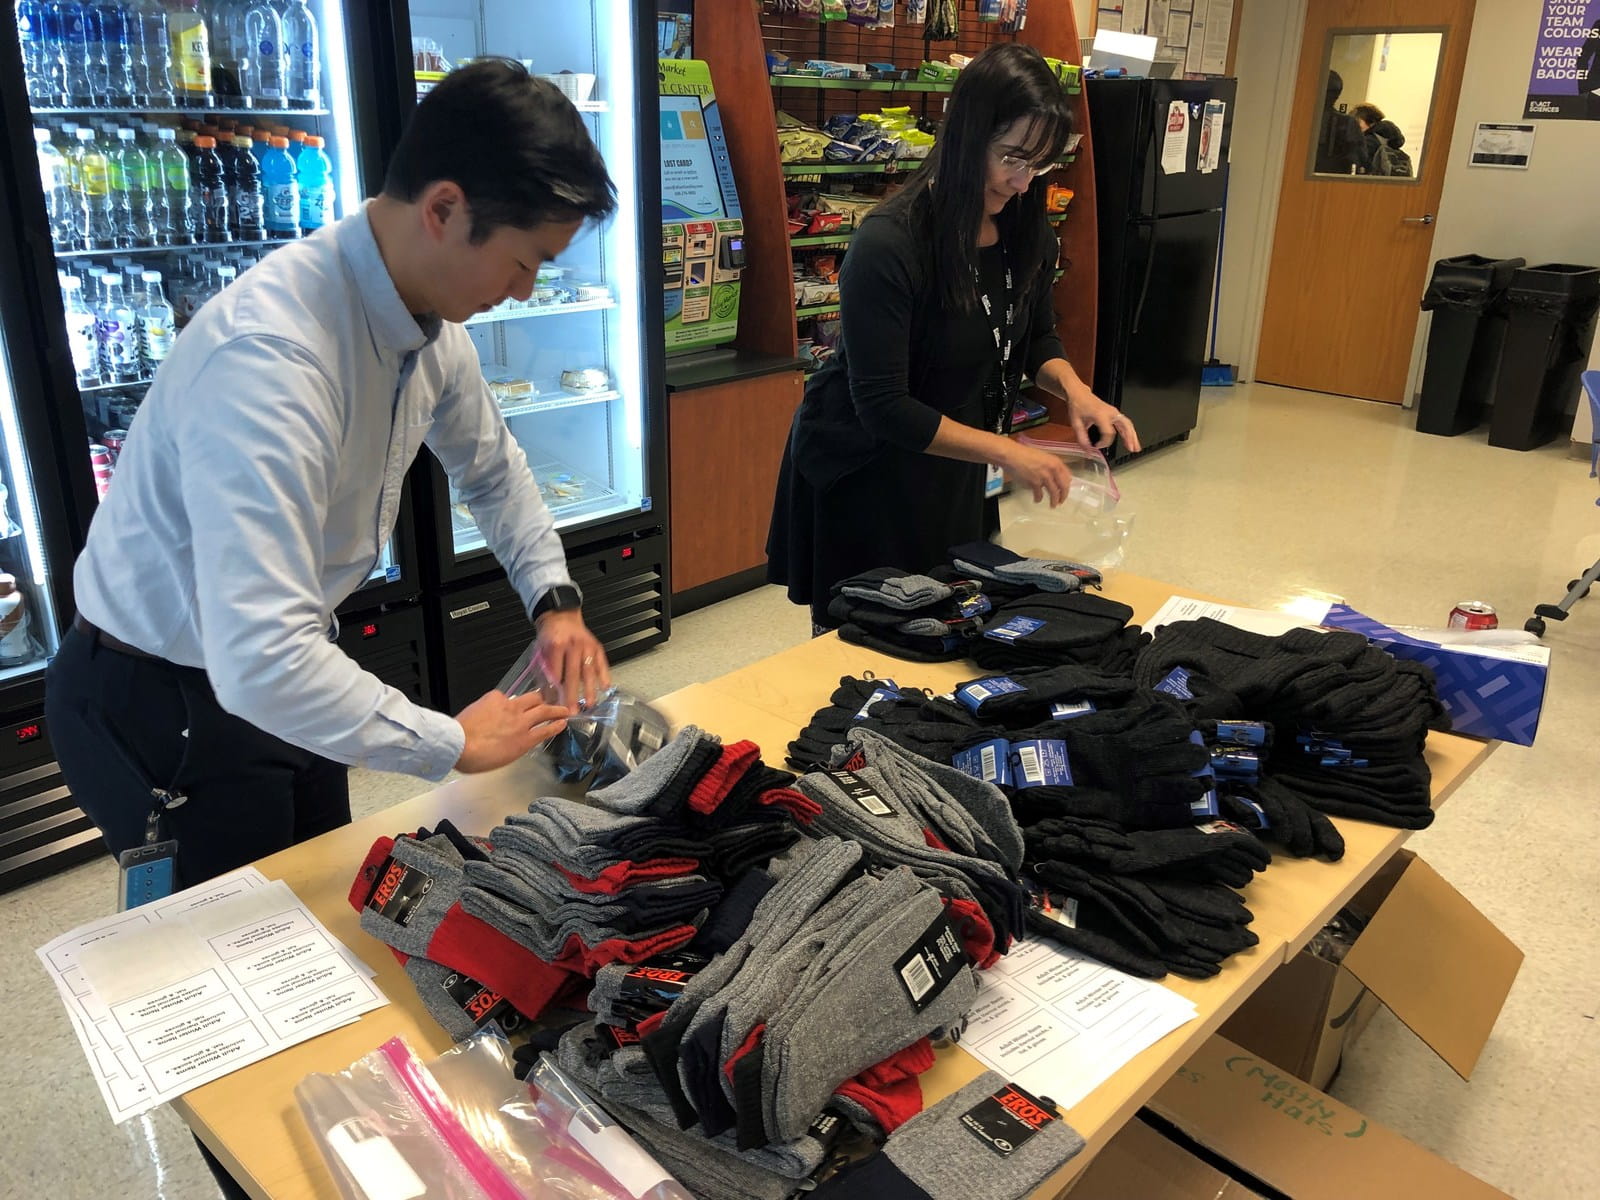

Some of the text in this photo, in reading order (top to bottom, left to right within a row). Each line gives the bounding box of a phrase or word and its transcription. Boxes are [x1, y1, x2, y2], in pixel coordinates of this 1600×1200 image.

[1548, 5, 1586, 16] YOUR
[1546, 17, 1584, 27] TEAM
[1541, 46, 1583, 57] WEAR
[1539, 58, 1577, 68] YOUR
[659, 63, 686, 76] Market
[1536, 69, 1589, 80] BADGE!
[671, 84, 710, 96] CENTER
[664, 160, 676, 168] LOST
[373, 864, 402, 905] EROS
[295, 948, 311, 956] Adult
[275, 954, 294, 963] Winter
[276, 972, 332, 995] Adult Winter Items
[140, 991, 202, 1016] Adult Winter Items
[294, 997, 351, 1023] Adult Winter Items
[157, 1018, 220, 1045] Adult Winter Items
[176, 1046, 240, 1075] Adult Winter Items
[999, 1090, 1048, 1125] EROS
